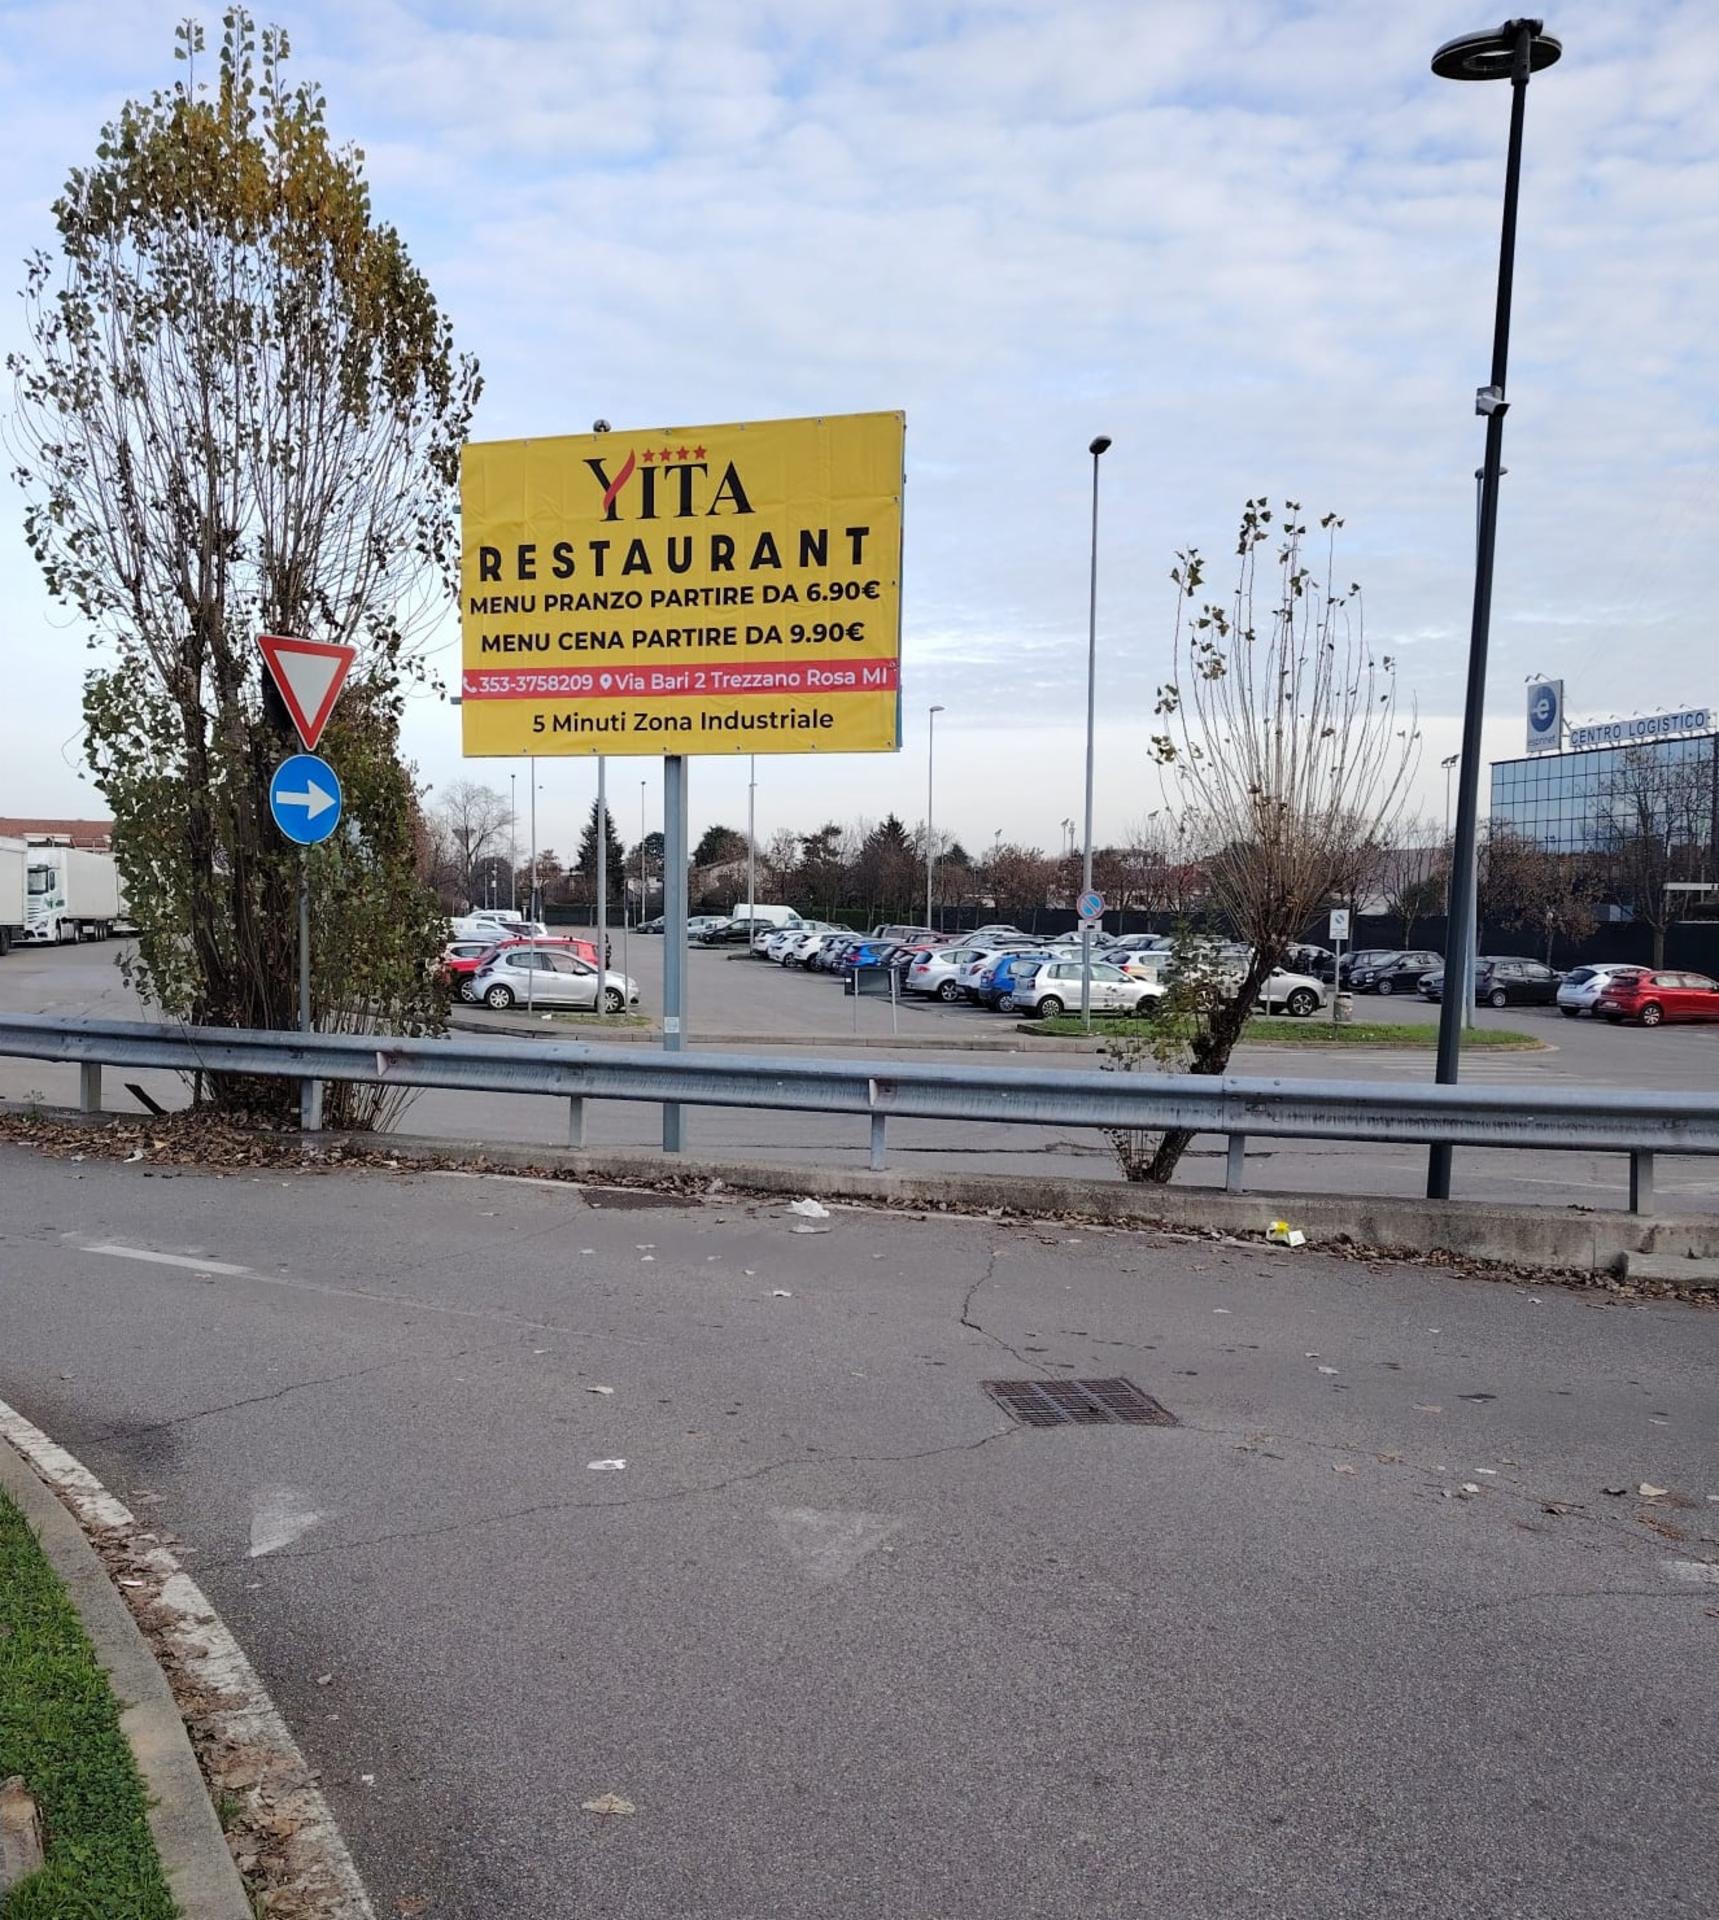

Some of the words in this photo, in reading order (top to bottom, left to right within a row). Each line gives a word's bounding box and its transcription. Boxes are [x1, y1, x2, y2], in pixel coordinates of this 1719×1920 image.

[582, 448, 756, 522] YITA
[479, 526, 870, 582] RESTAURANT
[469, 595, 536, 615] MENU
[544, 590, 643, 613] PRANZO
[650, 586, 754, 608] PARTIRE
[762, 584, 799, 604] DA
[806, 580, 881, 602] 6.90€
[481, 633, 550, 653] MENU
[558, 630, 624, 652] CENA
[632, 626, 737, 649] PARTIRE
[745, 625, 783, 645] DA
[790, 622, 865, 643] 9.90€
[479, 674, 594, 693] 353-3758209
[615, 672, 645, 691] Via
[651, 669, 689, 690] Bari
[695, 673, 706, 689] 2
[711, 671, 801, 689] Trezzano
[807, 669, 856, 686] Rosa
[863, 667, 888, 685] MI
[532, 714, 545, 733] 5
[552, 711, 626, 732] Minuti
[633, 711, 692, 731] Zona
[701, 708, 834, 731] Industriale
[1571, 724, 1622, 745] CENTRO
[1629, 711, 1705, 737] LOGISTICO
